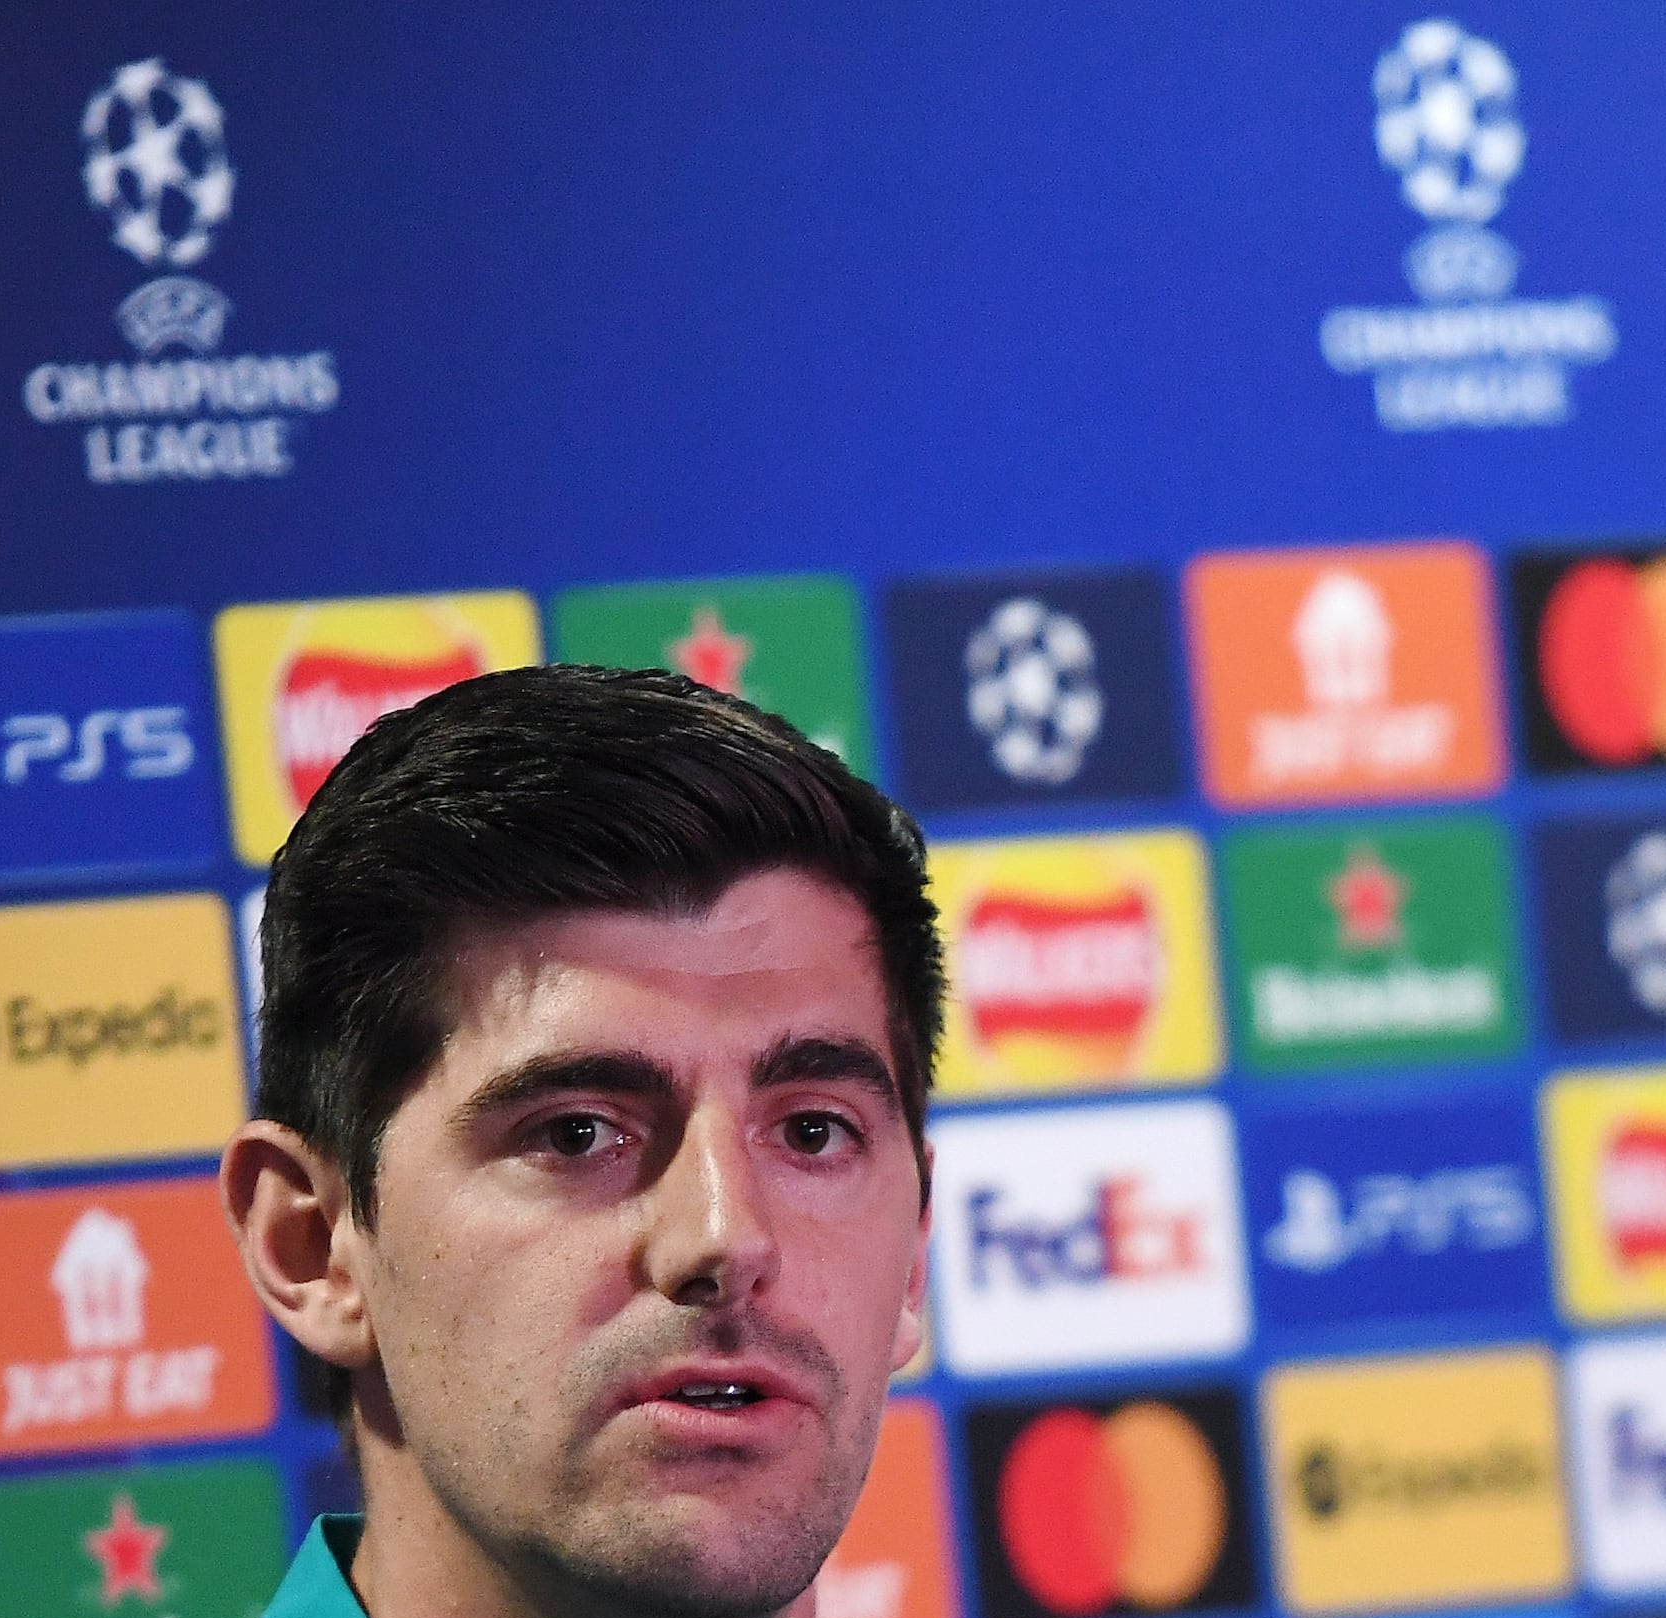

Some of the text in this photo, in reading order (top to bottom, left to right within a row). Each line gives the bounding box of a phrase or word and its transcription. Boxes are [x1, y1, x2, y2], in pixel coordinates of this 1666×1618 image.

[25, 351, 339, 423] CHAMPIONS
[87, 418, 291, 483] LEAGUE
[1, 706, 196, 785] PS5
